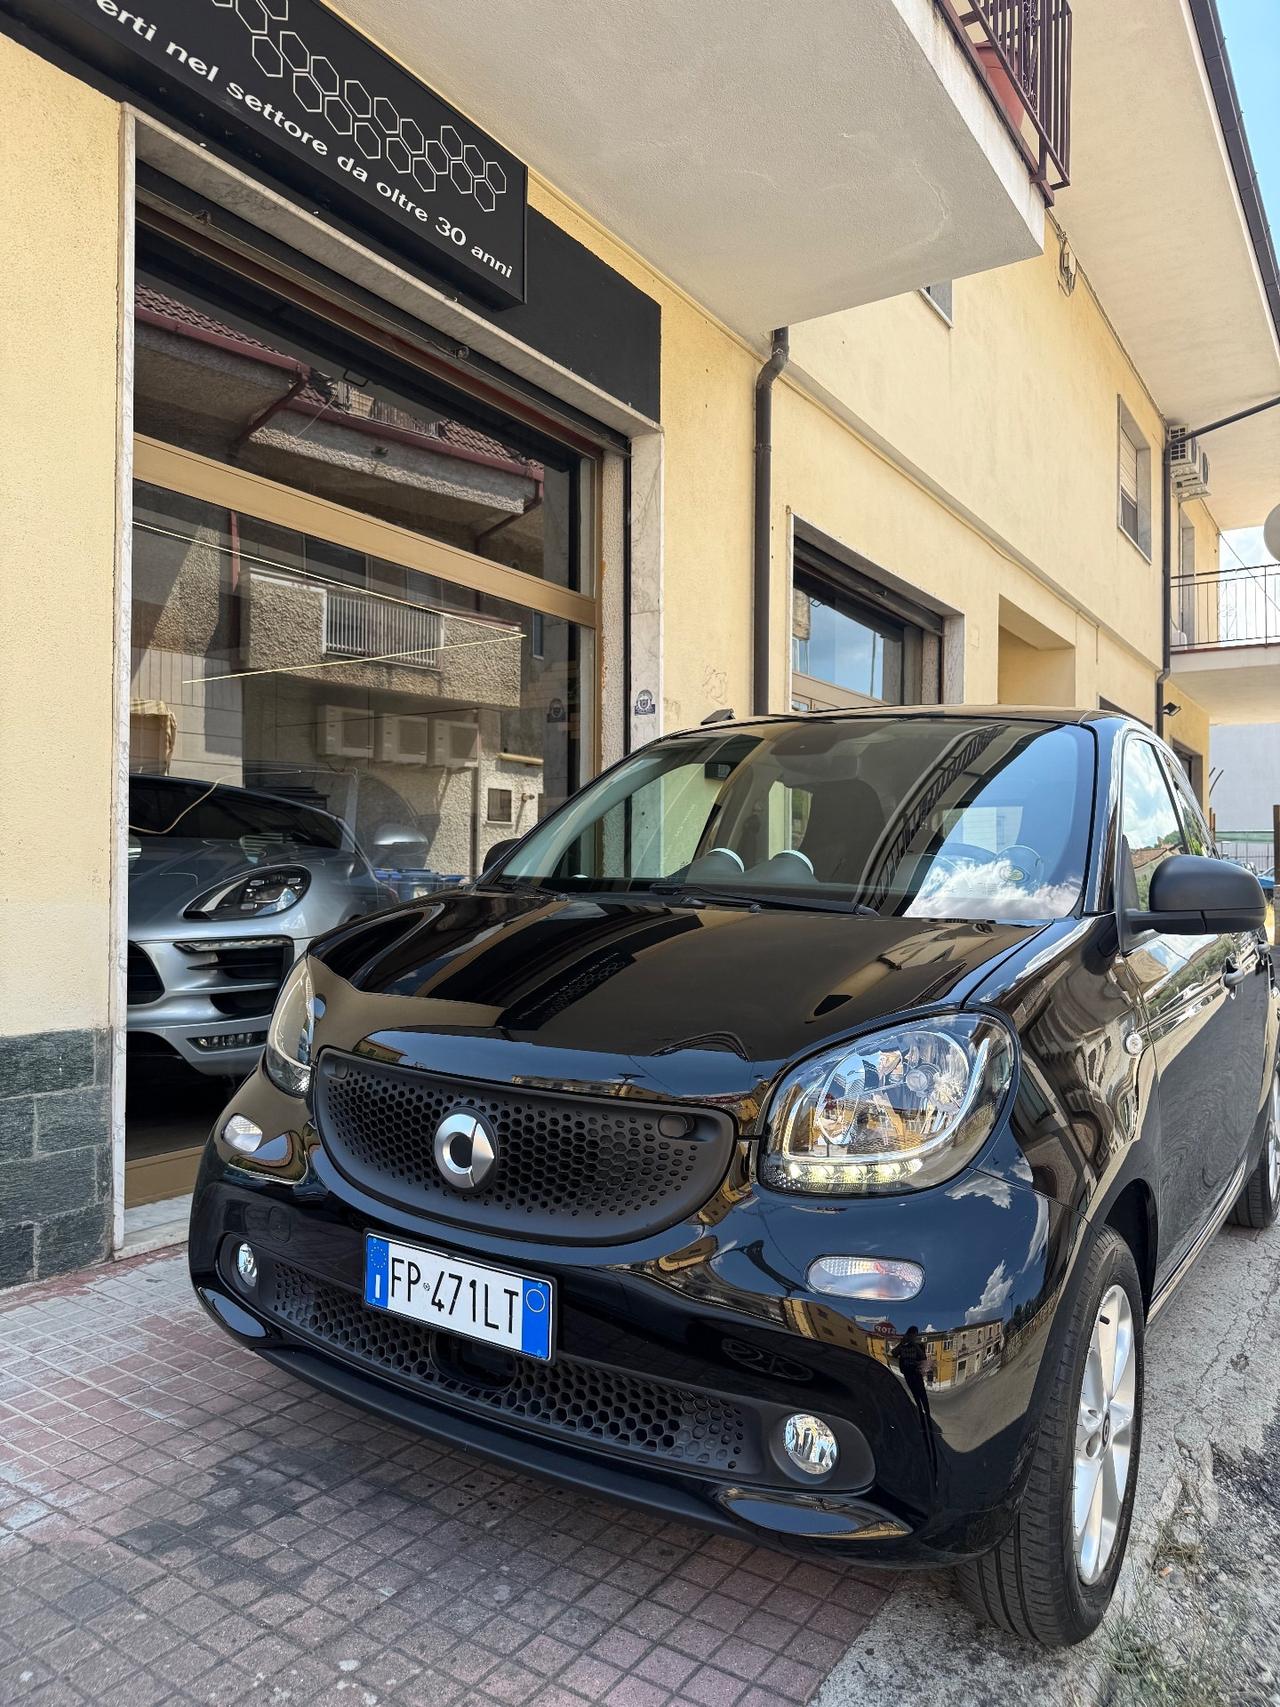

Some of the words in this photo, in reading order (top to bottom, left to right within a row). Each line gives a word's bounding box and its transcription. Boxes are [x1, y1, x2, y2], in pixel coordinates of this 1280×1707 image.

[166, 42, 219, 82] nel
[227, 82, 328, 156] settore
[338, 155, 369, 182] da
[377, 181, 429, 222] oltre
[435, 217, 467, 246] 30
[471, 244, 513, 279] anni
